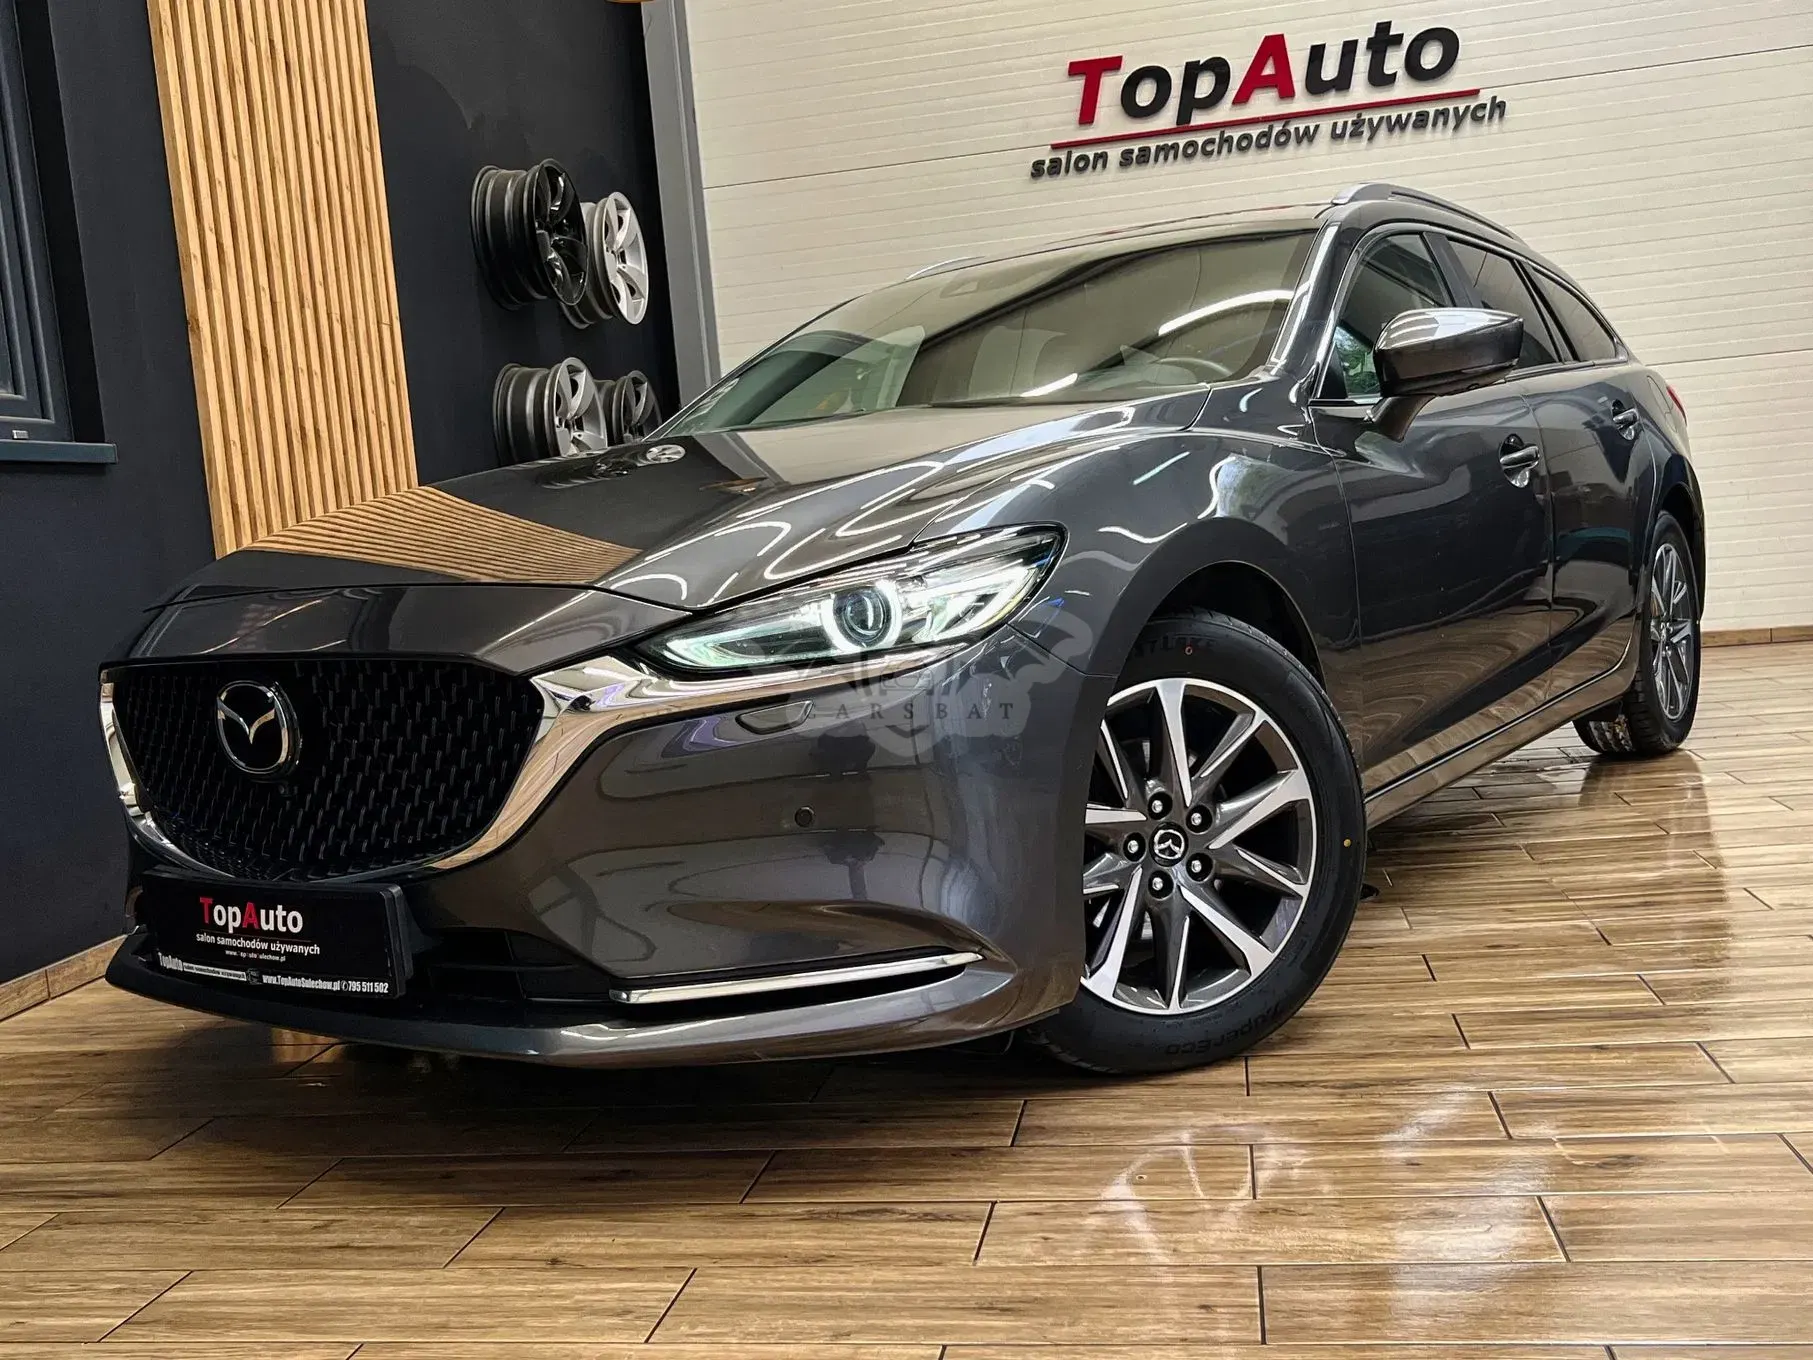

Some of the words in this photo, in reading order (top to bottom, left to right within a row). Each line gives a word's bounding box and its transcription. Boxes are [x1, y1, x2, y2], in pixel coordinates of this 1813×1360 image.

[1068, 20, 1460, 126] TopAuto
[1030, 150, 1108, 178] salon
[1119, 119, 1320, 169] samochodów
[1330, 96, 1506, 143] używanych
[200, 896, 304, 934] TopAuto
[196, 932, 216, 945] salon
[216, 935, 268, 951] samochodów
[270, 940, 320, 955] używanych
[348, 980, 361, 992] 795
[361, 981, 374, 993] 511
[374, 982, 389, 994] 502
